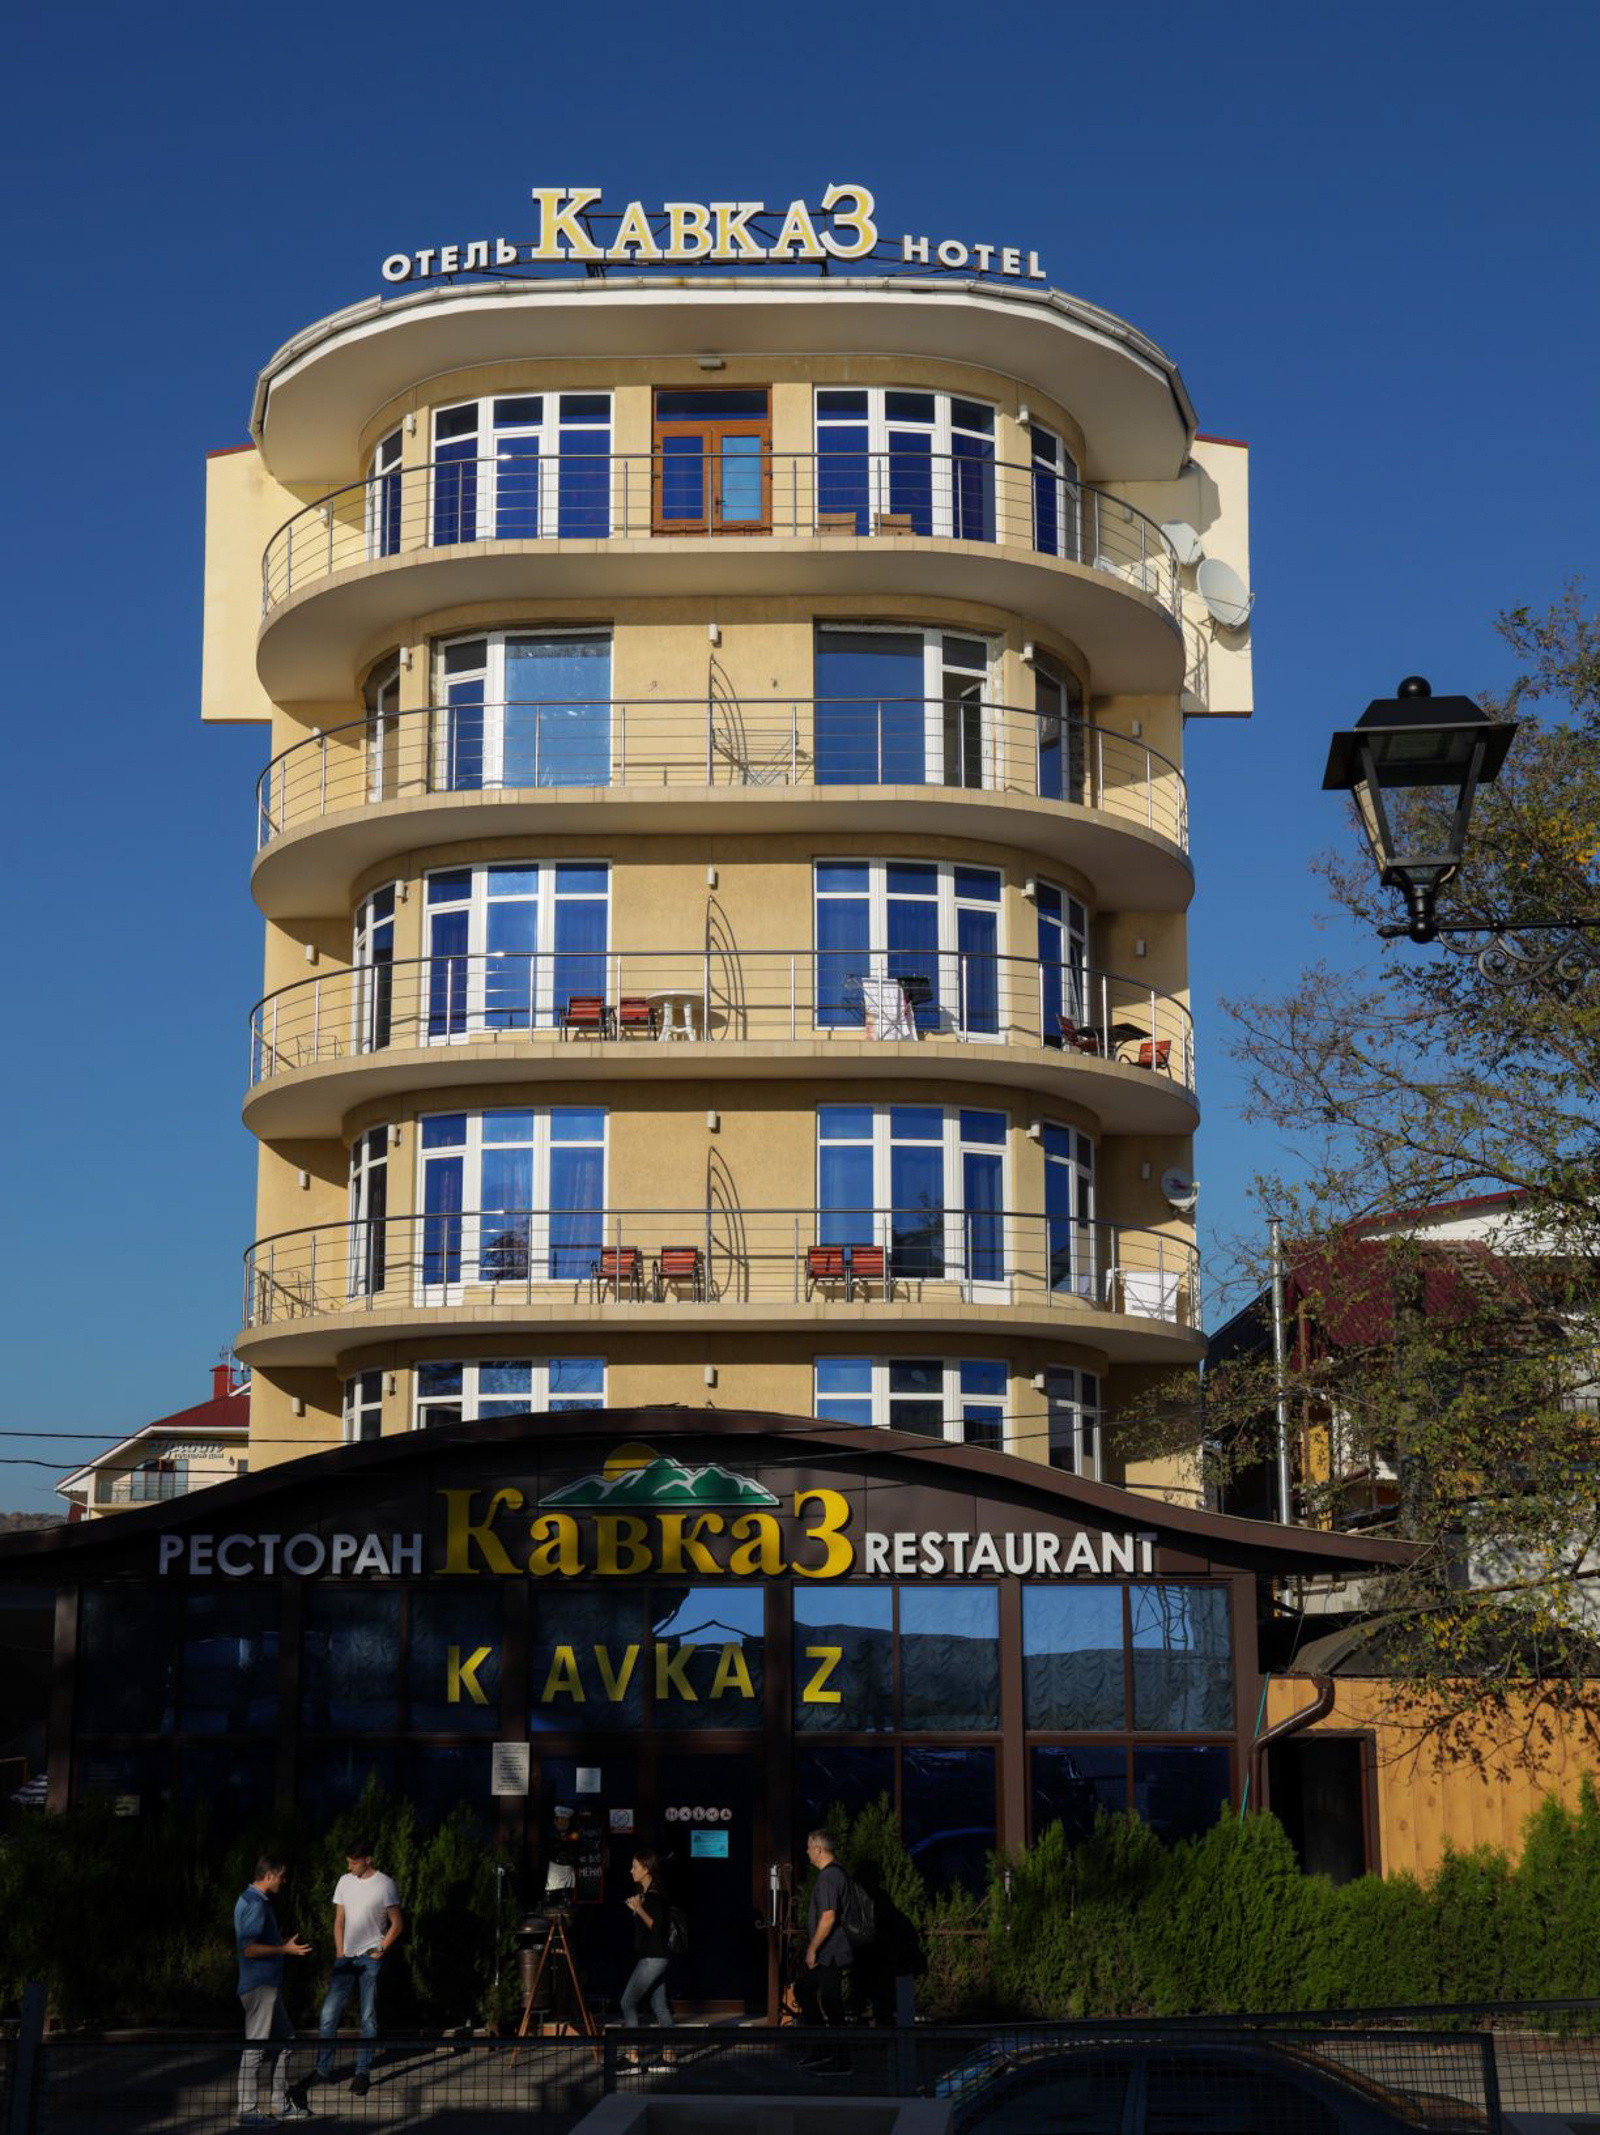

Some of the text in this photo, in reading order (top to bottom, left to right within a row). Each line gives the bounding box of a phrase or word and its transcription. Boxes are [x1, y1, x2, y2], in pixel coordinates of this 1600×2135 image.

[381, 238, 517, 283] ОТЕЛЬ
[903, 234, 1047, 280] HOTEL
[158, 1532, 422, 1577] РЕСТОРАН
[865, 1531, 1158, 1574] RESTAURANT
